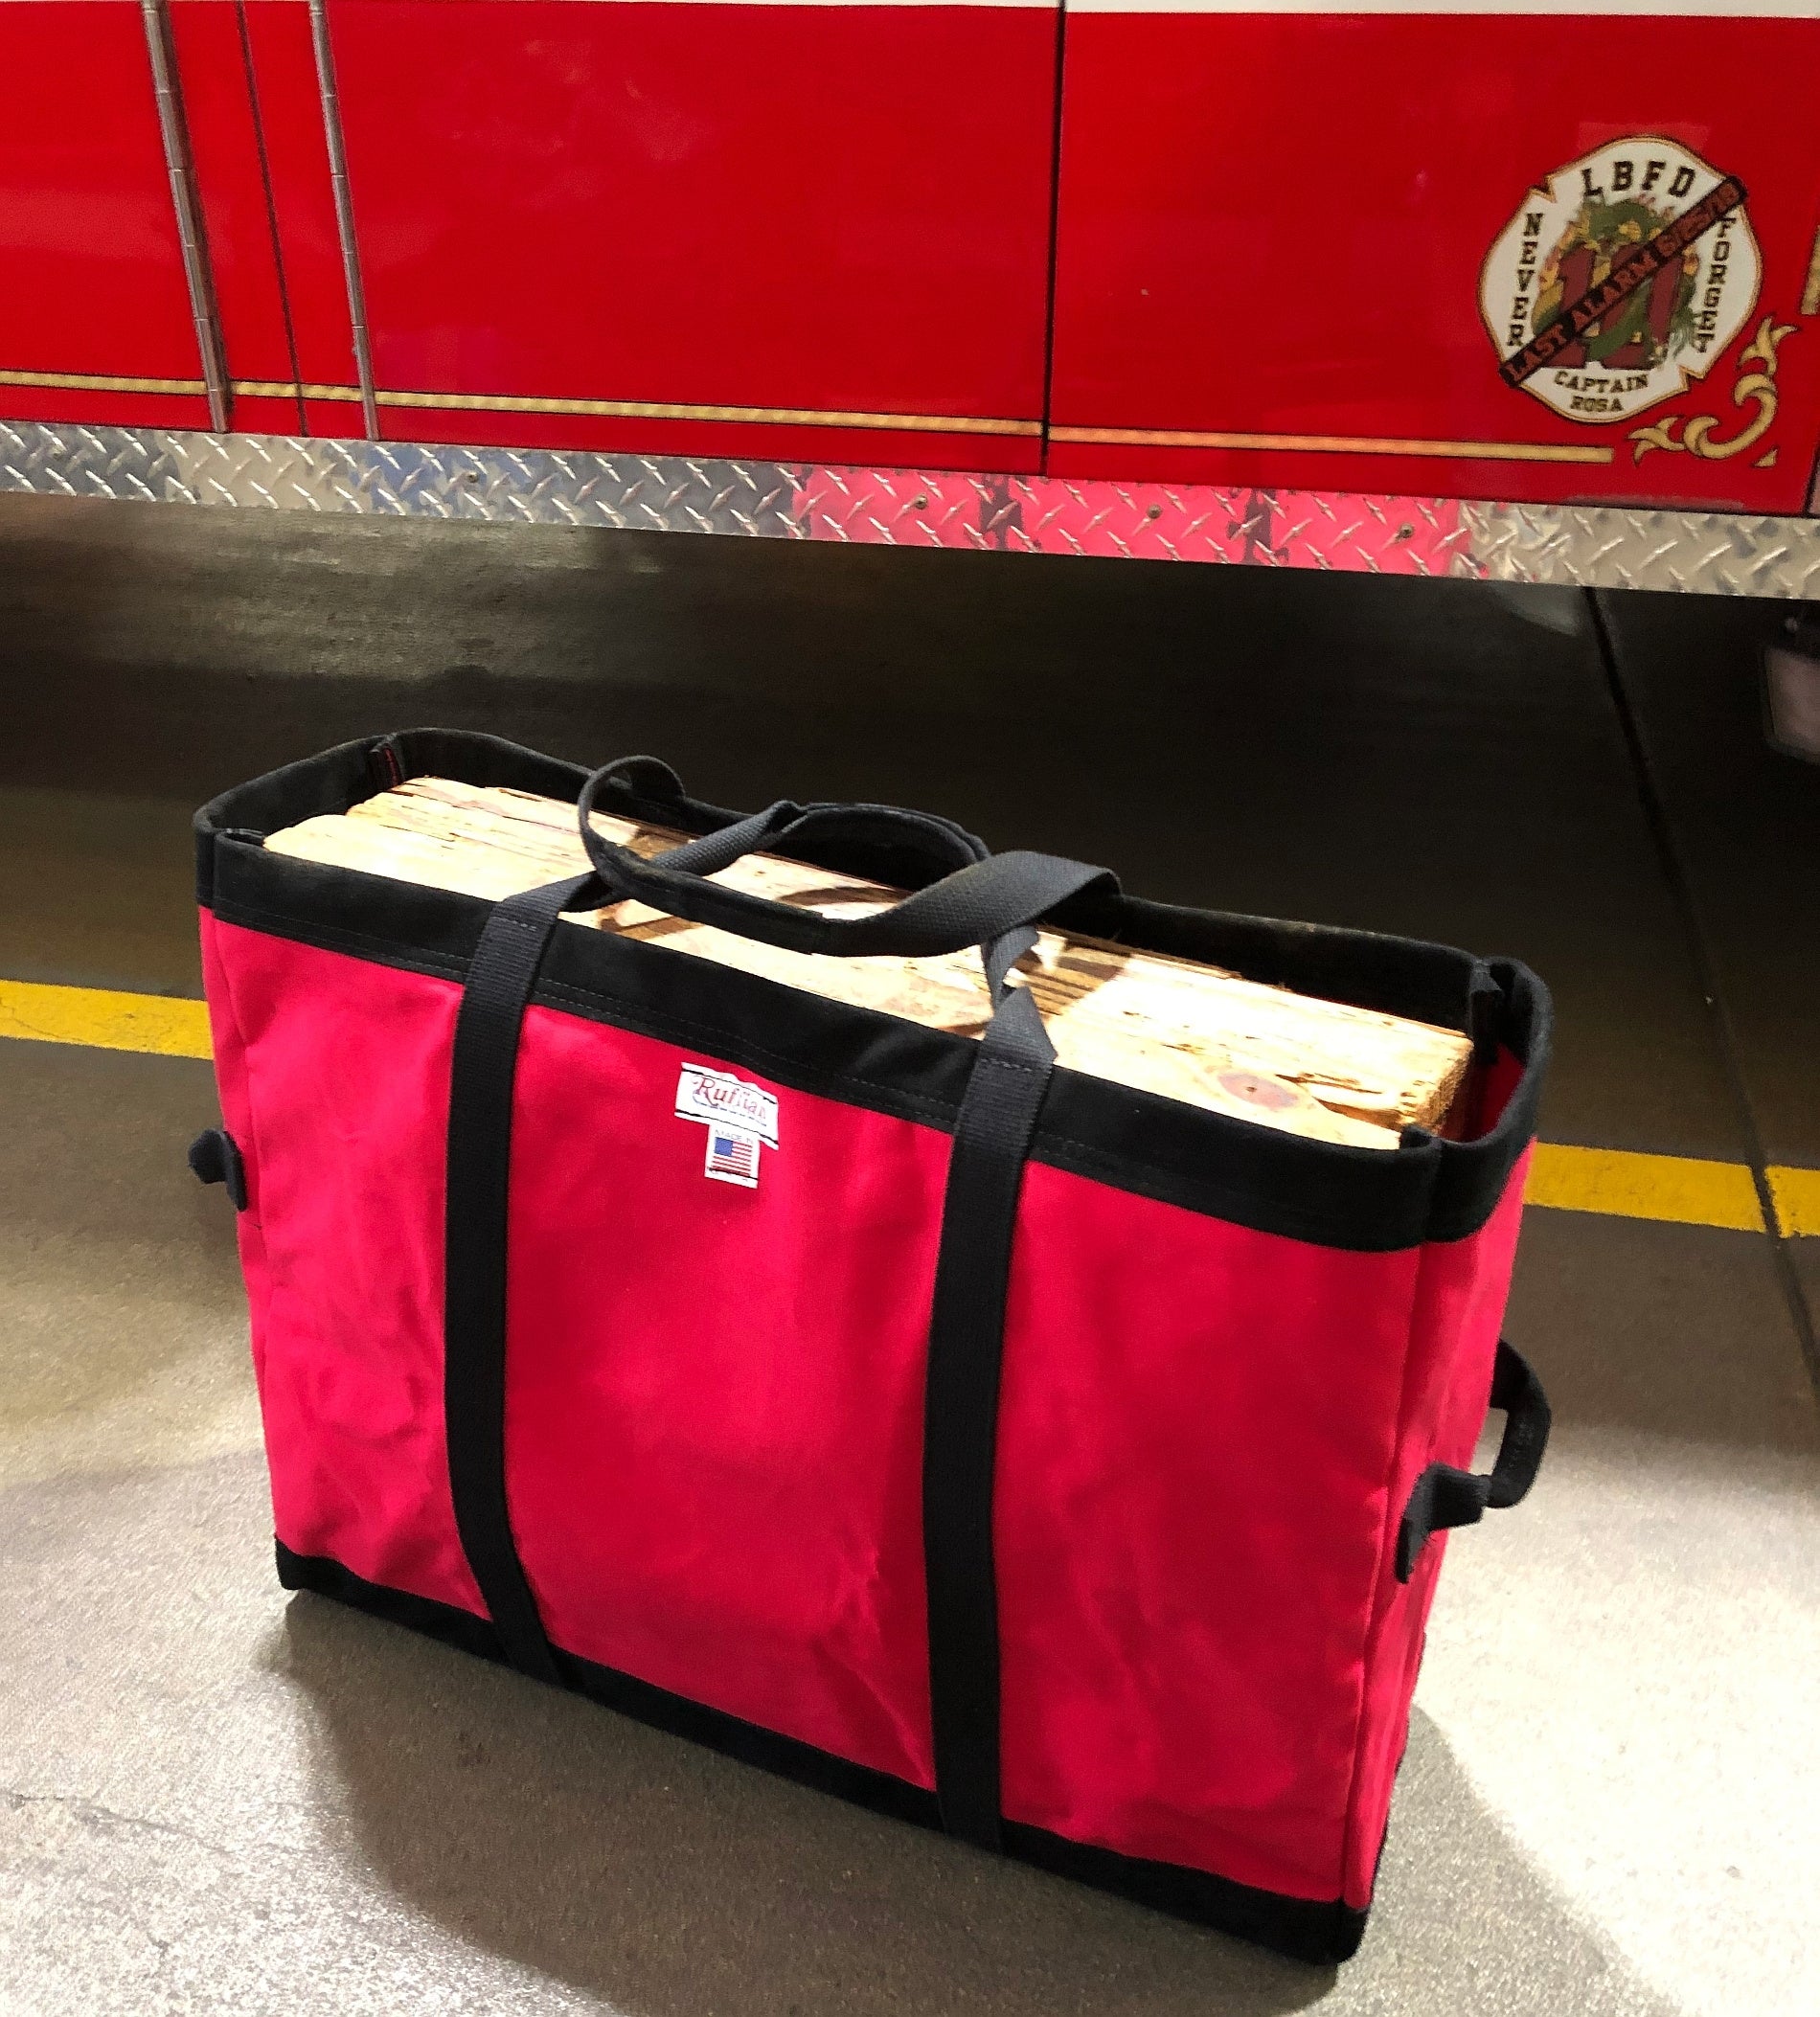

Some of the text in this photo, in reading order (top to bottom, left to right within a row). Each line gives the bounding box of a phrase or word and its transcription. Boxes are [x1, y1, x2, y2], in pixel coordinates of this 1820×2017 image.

[1581, 161, 1696, 198] LBFD
[1505, 323, 1568, 382] LAST
[1571, 250, 1658, 332] ALARM
[1506, 213, 1544, 347] NEVER
[1695, 217, 1737, 353] FORGET
[1554, 371, 1649, 394] CAPTAIN
[1570, 396, 1625, 413] ROSA
